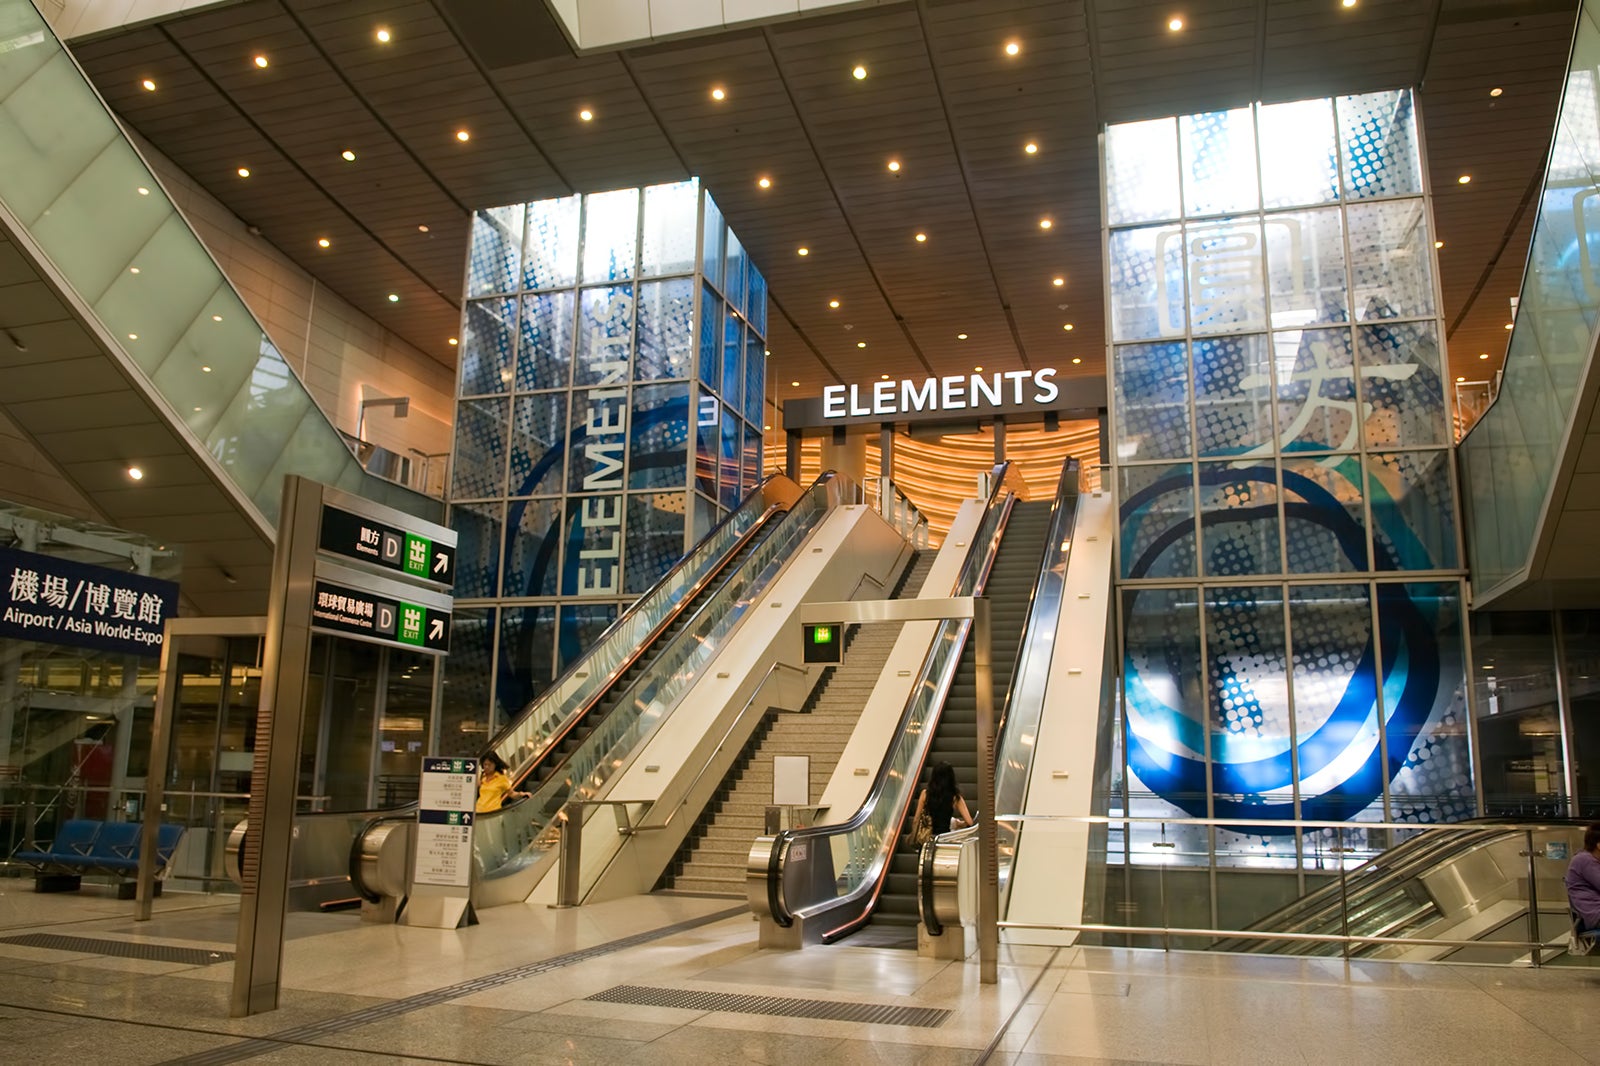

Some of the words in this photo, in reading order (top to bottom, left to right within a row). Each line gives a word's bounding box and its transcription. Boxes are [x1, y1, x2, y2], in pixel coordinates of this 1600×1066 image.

[823, 368, 1059, 418] ELEMENTS
[577, 293, 633, 597] ELEMENTS
[386, 537, 398, 558] D
[409, 539, 426, 564] 出
[409, 561, 424, 571] EXIT
[8, 566, 164, 626] 機場/博覽館
[3, 606, 55, 628] Airport
[55, 615, 65, 630] /
[65, 616, 92, 634] Asia
[94, 620, 164, 646] World-Expo
[380, 608, 392, 629] D
[404, 608, 421, 632] 出
[403, 630, 418, 640] EXIT
